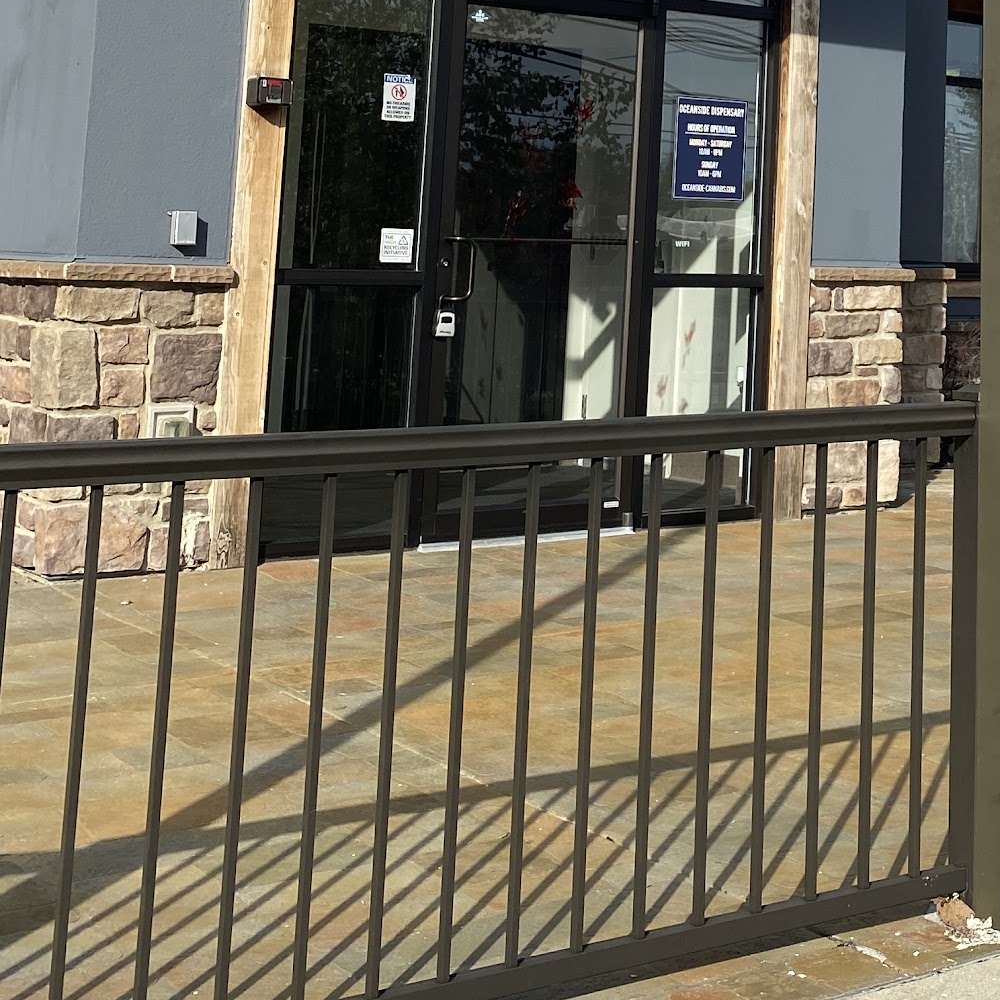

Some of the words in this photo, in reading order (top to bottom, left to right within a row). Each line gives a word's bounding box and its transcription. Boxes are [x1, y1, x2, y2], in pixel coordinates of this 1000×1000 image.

[680, 104, 710, 116] OCEANSIDE
[711, 106, 744, 118] DISPENSARY
[688, 123, 704, 132] HOURS
[704, 124, 710, 132] OF
[710, 124, 736, 134] OPERATION
[689, 138, 707, 146] MONDAY
[710, 140, 732, 148] SATURDAY
[701, 161, 719, 169] SUNDAY
